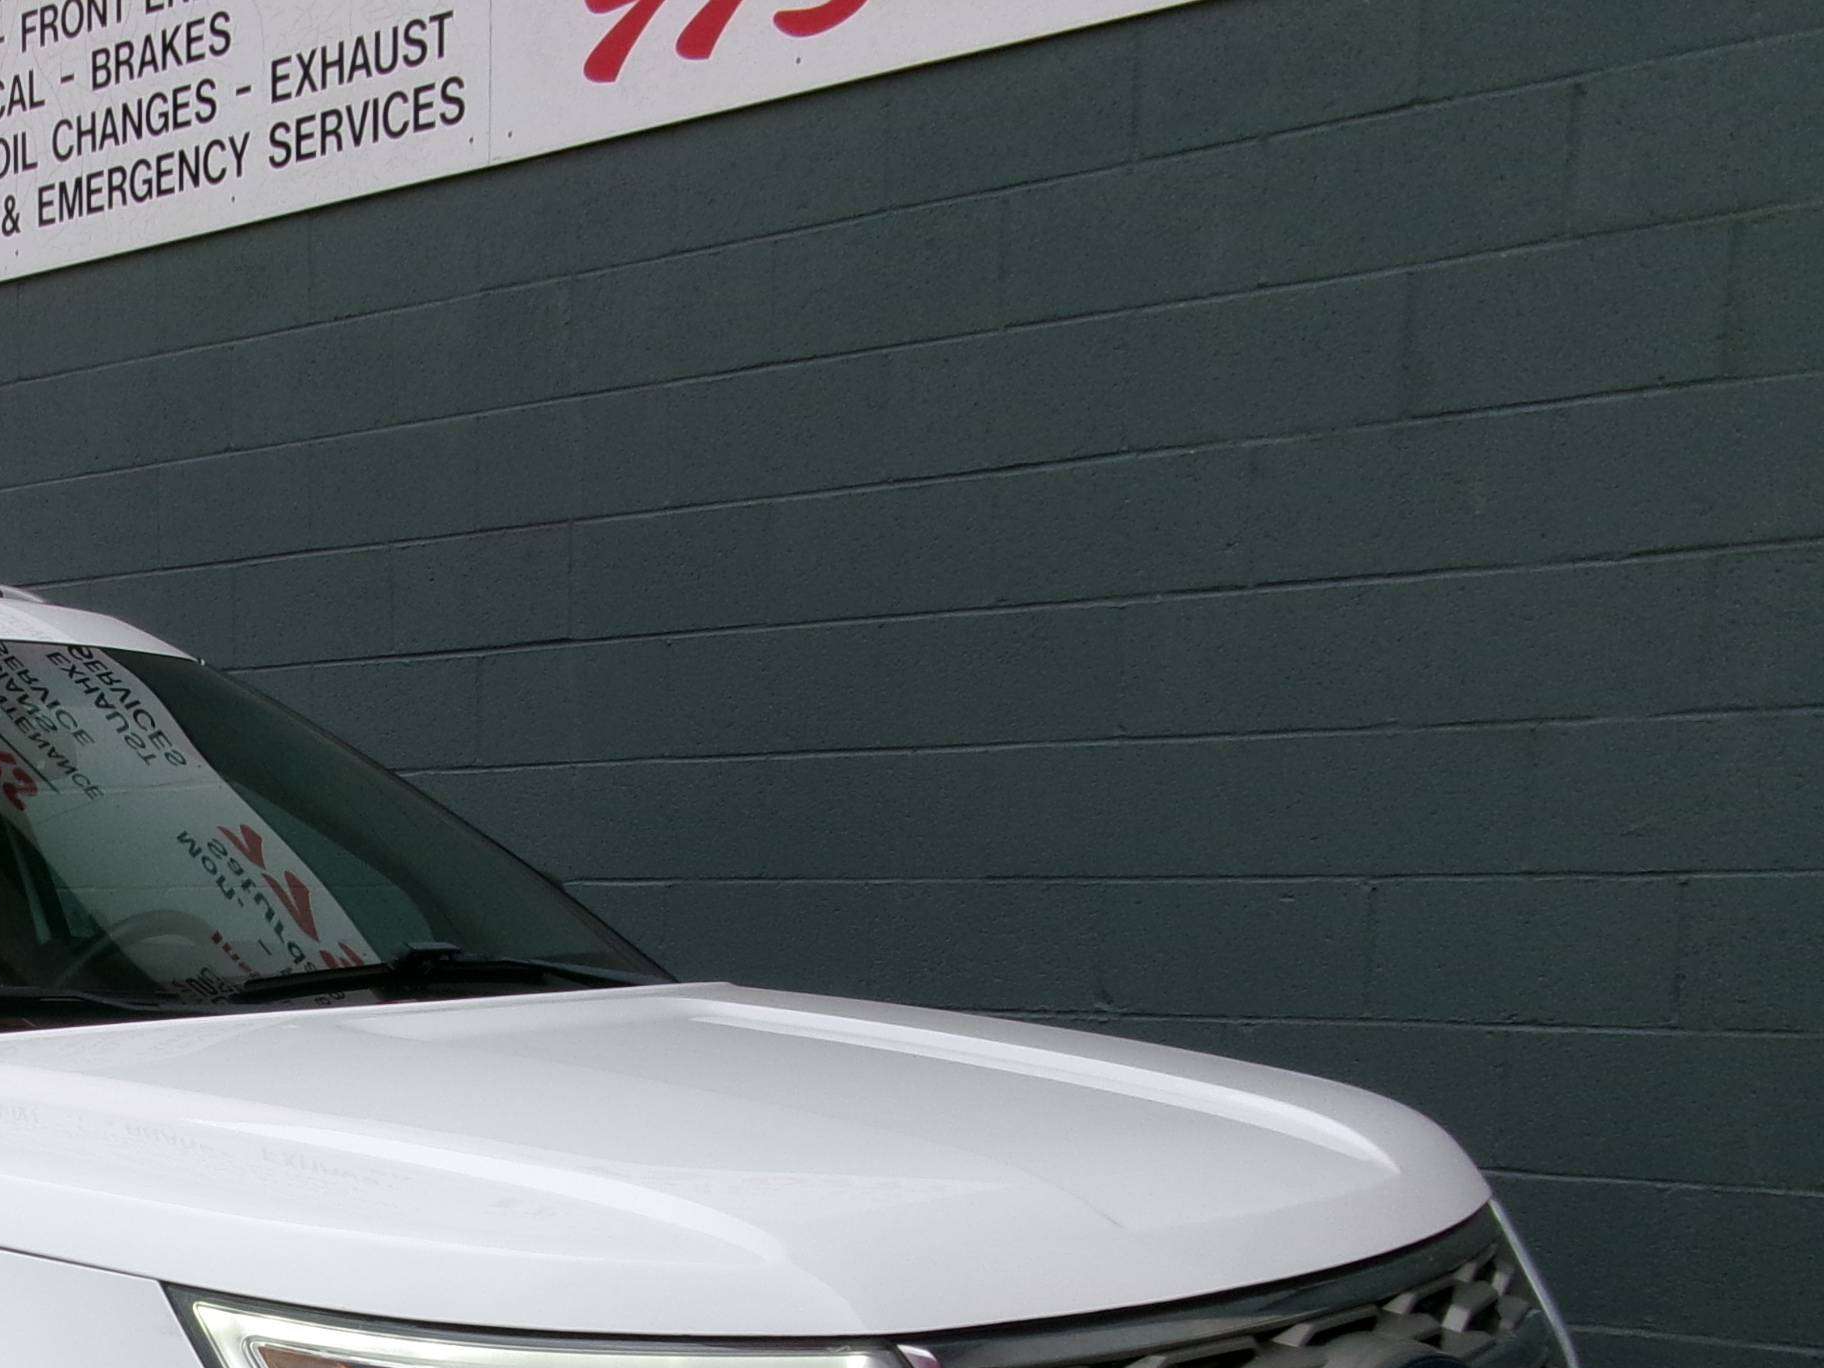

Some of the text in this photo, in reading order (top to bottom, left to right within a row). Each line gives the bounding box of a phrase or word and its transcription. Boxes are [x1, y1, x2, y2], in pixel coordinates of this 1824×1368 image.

[21, 0, 122, 53] FRONT
[92, 11, 231, 91] BRAKES
[52, 78, 217, 162] CHANGES
[271, 10, 454, 104] EXHAUST
[1, 195, 21, 237] &
[38, 131, 250, 227] EMERGENCY
[269, 76, 466, 169] SERVICES
